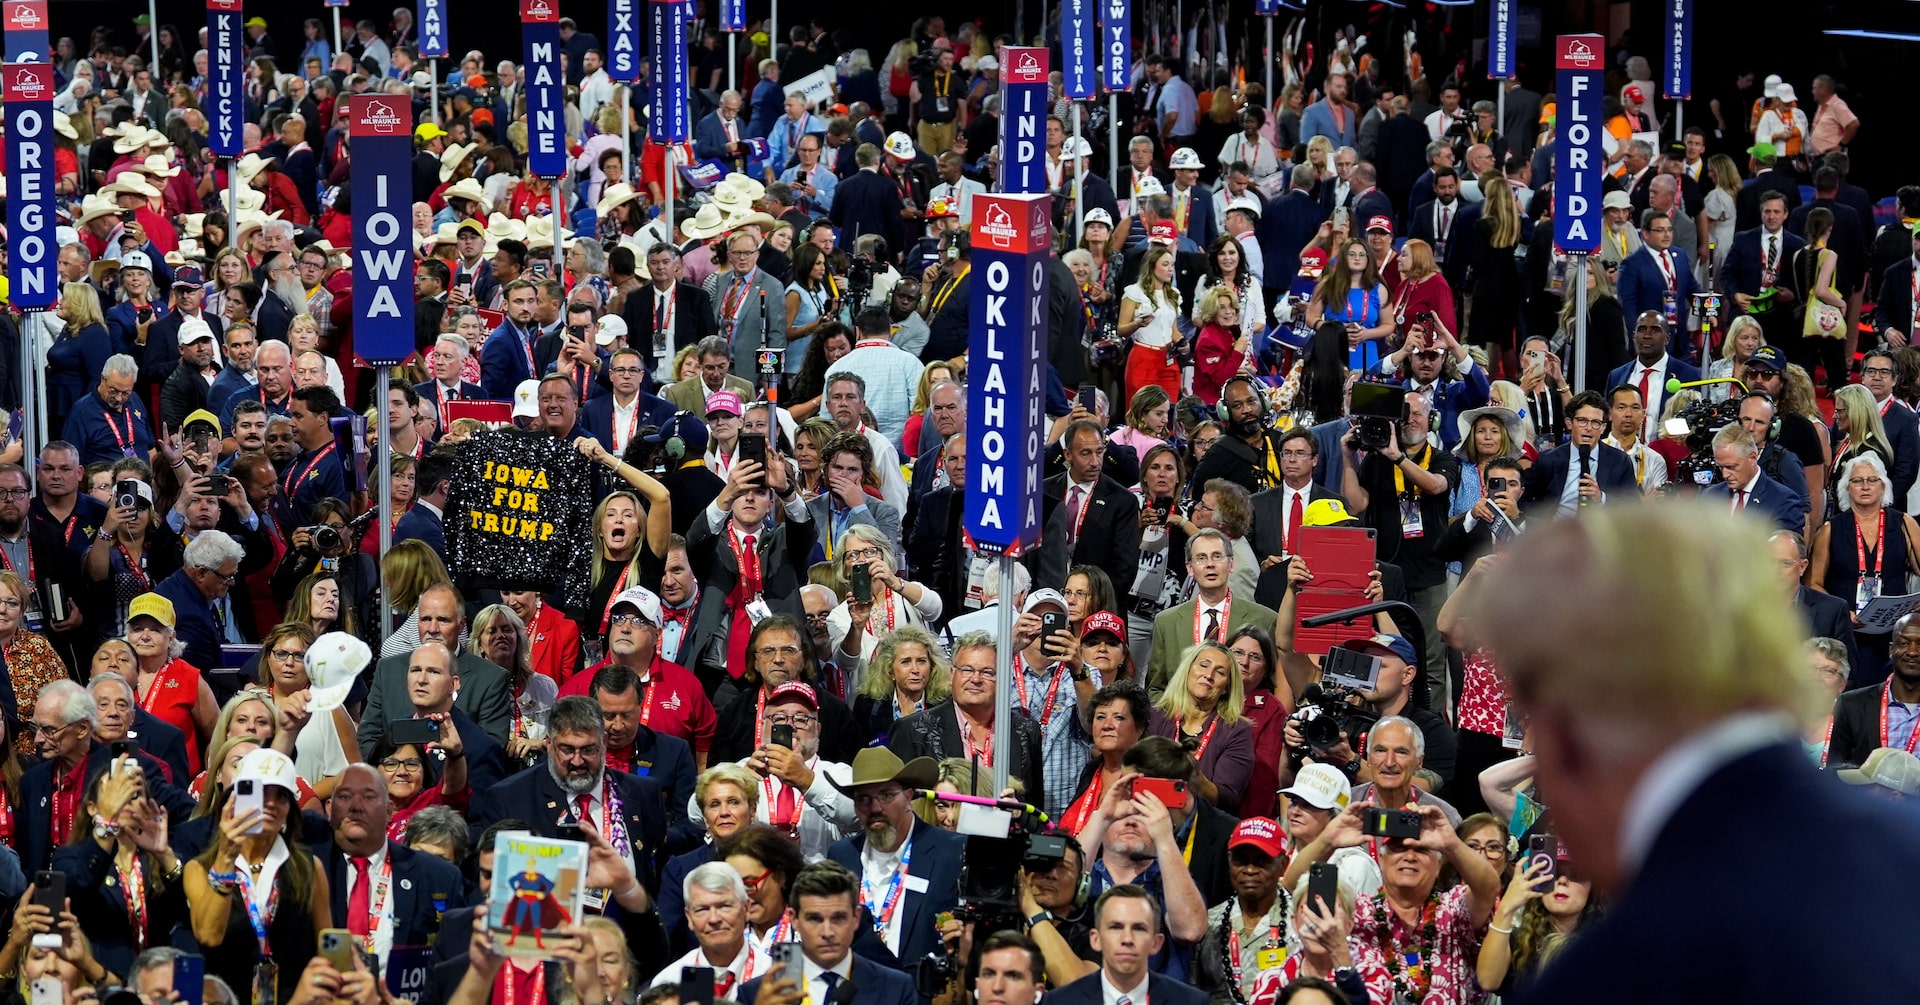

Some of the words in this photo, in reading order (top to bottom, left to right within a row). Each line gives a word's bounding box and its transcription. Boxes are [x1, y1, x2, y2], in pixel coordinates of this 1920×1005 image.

[654, 5, 663, 83] AMERICAN
[674, 5, 682, 83] AMERICAN
[1073, 19, 1085, 93] VIRGINIA
[1111, 26, 1125, 85] YORK
[1672, 22, 1683, 94] HAMPSHIRE
[217, 14, 232, 147] KENTUCKY
[531, 42, 556, 153] MAINE
[1018, 90, 1036, 194] INDI
[1567, 76, 1590, 241] FLORIDA
[16, 109, 44, 296] OREGON
[980, 225, 1018, 238] MILWAUKEE
[360, 174, 406, 318] IOWA
[980, 260, 1010, 530] OKLAHOMA
[1024, 260, 1043, 529] OKLAHOMA
[484, 461, 549, 490] IOWA
[493, 487, 538, 513] FOR
[470, 510, 554, 541] TRUMP
[1094, 612, 1113, 622] SAVE
[258, 755, 288, 777] 47
[508, 840, 564, 857] TRUMP
[1239, 819, 1277, 832] HAWAII
[1239, 828, 1274, 839] TRUMP
[885, 881, 899, 905] TRUMP
